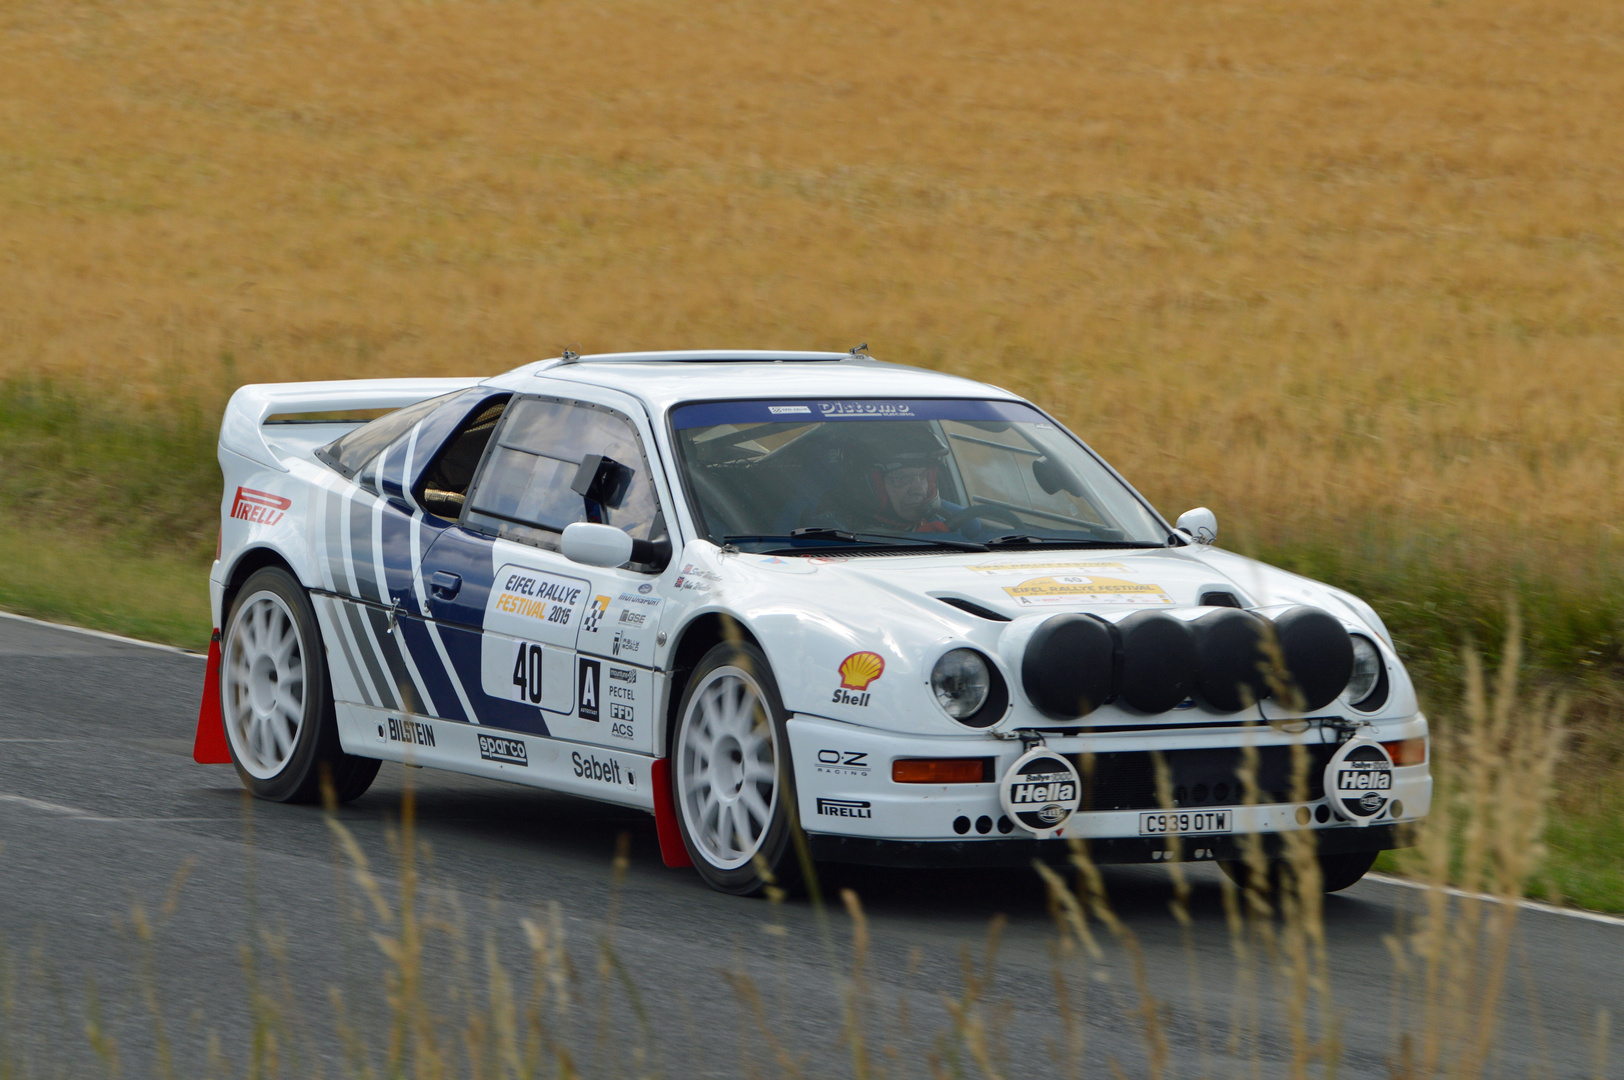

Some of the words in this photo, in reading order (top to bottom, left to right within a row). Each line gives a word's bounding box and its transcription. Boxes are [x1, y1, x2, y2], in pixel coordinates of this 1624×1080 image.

[818, 401, 910, 413] Distomo
[230, 486, 292, 526] PIRELLI
[505, 574, 536, 596] EIFEL
[536, 581, 581, 606] RALLYE
[496, 593, 547, 620] FESTIVAL
[548, 605, 572, 625] 2015
[513, 641, 543, 704] 40
[582, 666, 596, 707] A
[609, 685, 635, 701] PECTEL
[832, 689, 871, 707] Shell
[611, 703, 633, 721] FFD
[388, 718, 436, 747] BILSTEIN
[611, 722, 633, 737] ACS
[480, 736, 526, 757] sparco
[572, 751, 621, 784] Sabelt
[817, 768, 868, 777] RACING
[1340, 771, 1390, 789] Hella
[1014, 783, 1074, 803] Hella
[816, 798, 872, 819] PIRELLI
[1147, 814, 1189, 832] C939
[1194, 812, 1225, 830] OTW
